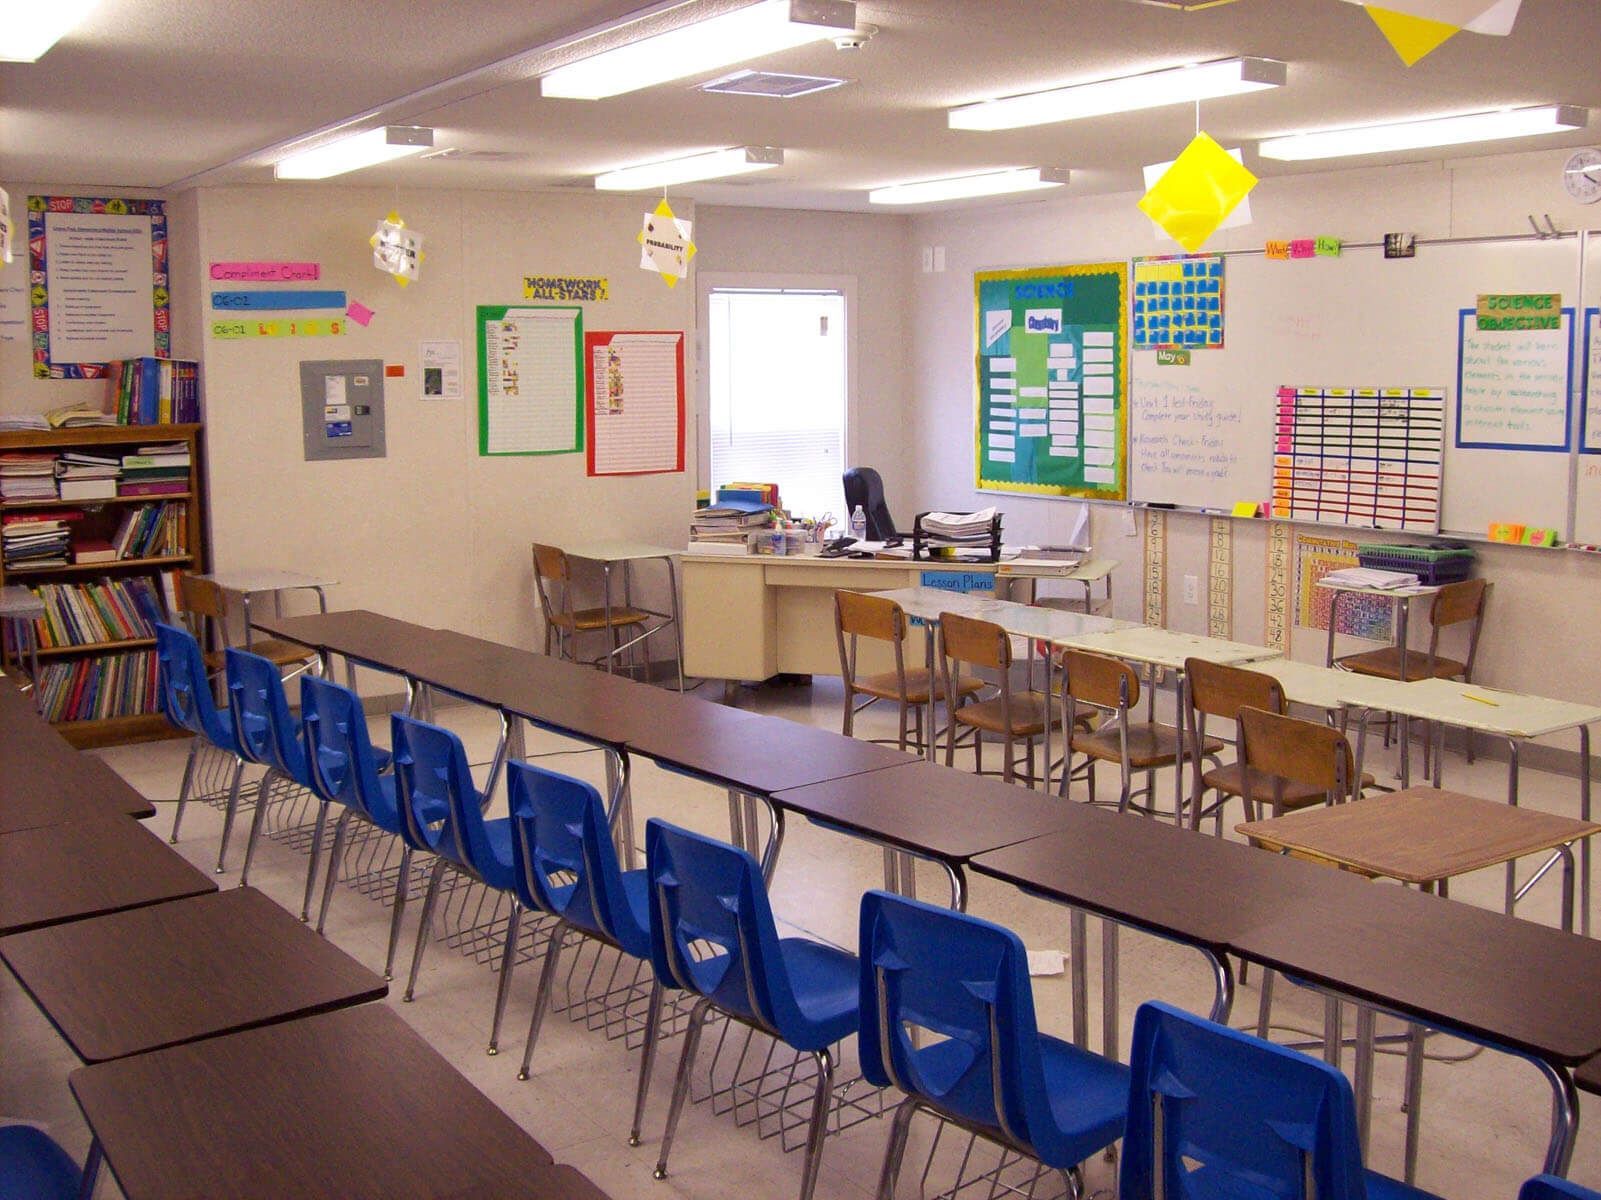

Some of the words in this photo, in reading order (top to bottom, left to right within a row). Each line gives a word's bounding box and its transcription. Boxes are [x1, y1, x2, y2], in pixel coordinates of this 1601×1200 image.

[49, 199, 73, 211] STOP
[646, 239, 684, 252] PROBABILITY
[526, 277, 601, 290] HOMEWORK
[1487, 295, 1554, 309] SCIENCE
[1477, 315, 1560, 330] OBJECTIVE
[1158, 351, 1176, 363] May
[922, 573, 960, 590] Lesson
[963, 574, 993, 590] Plans
